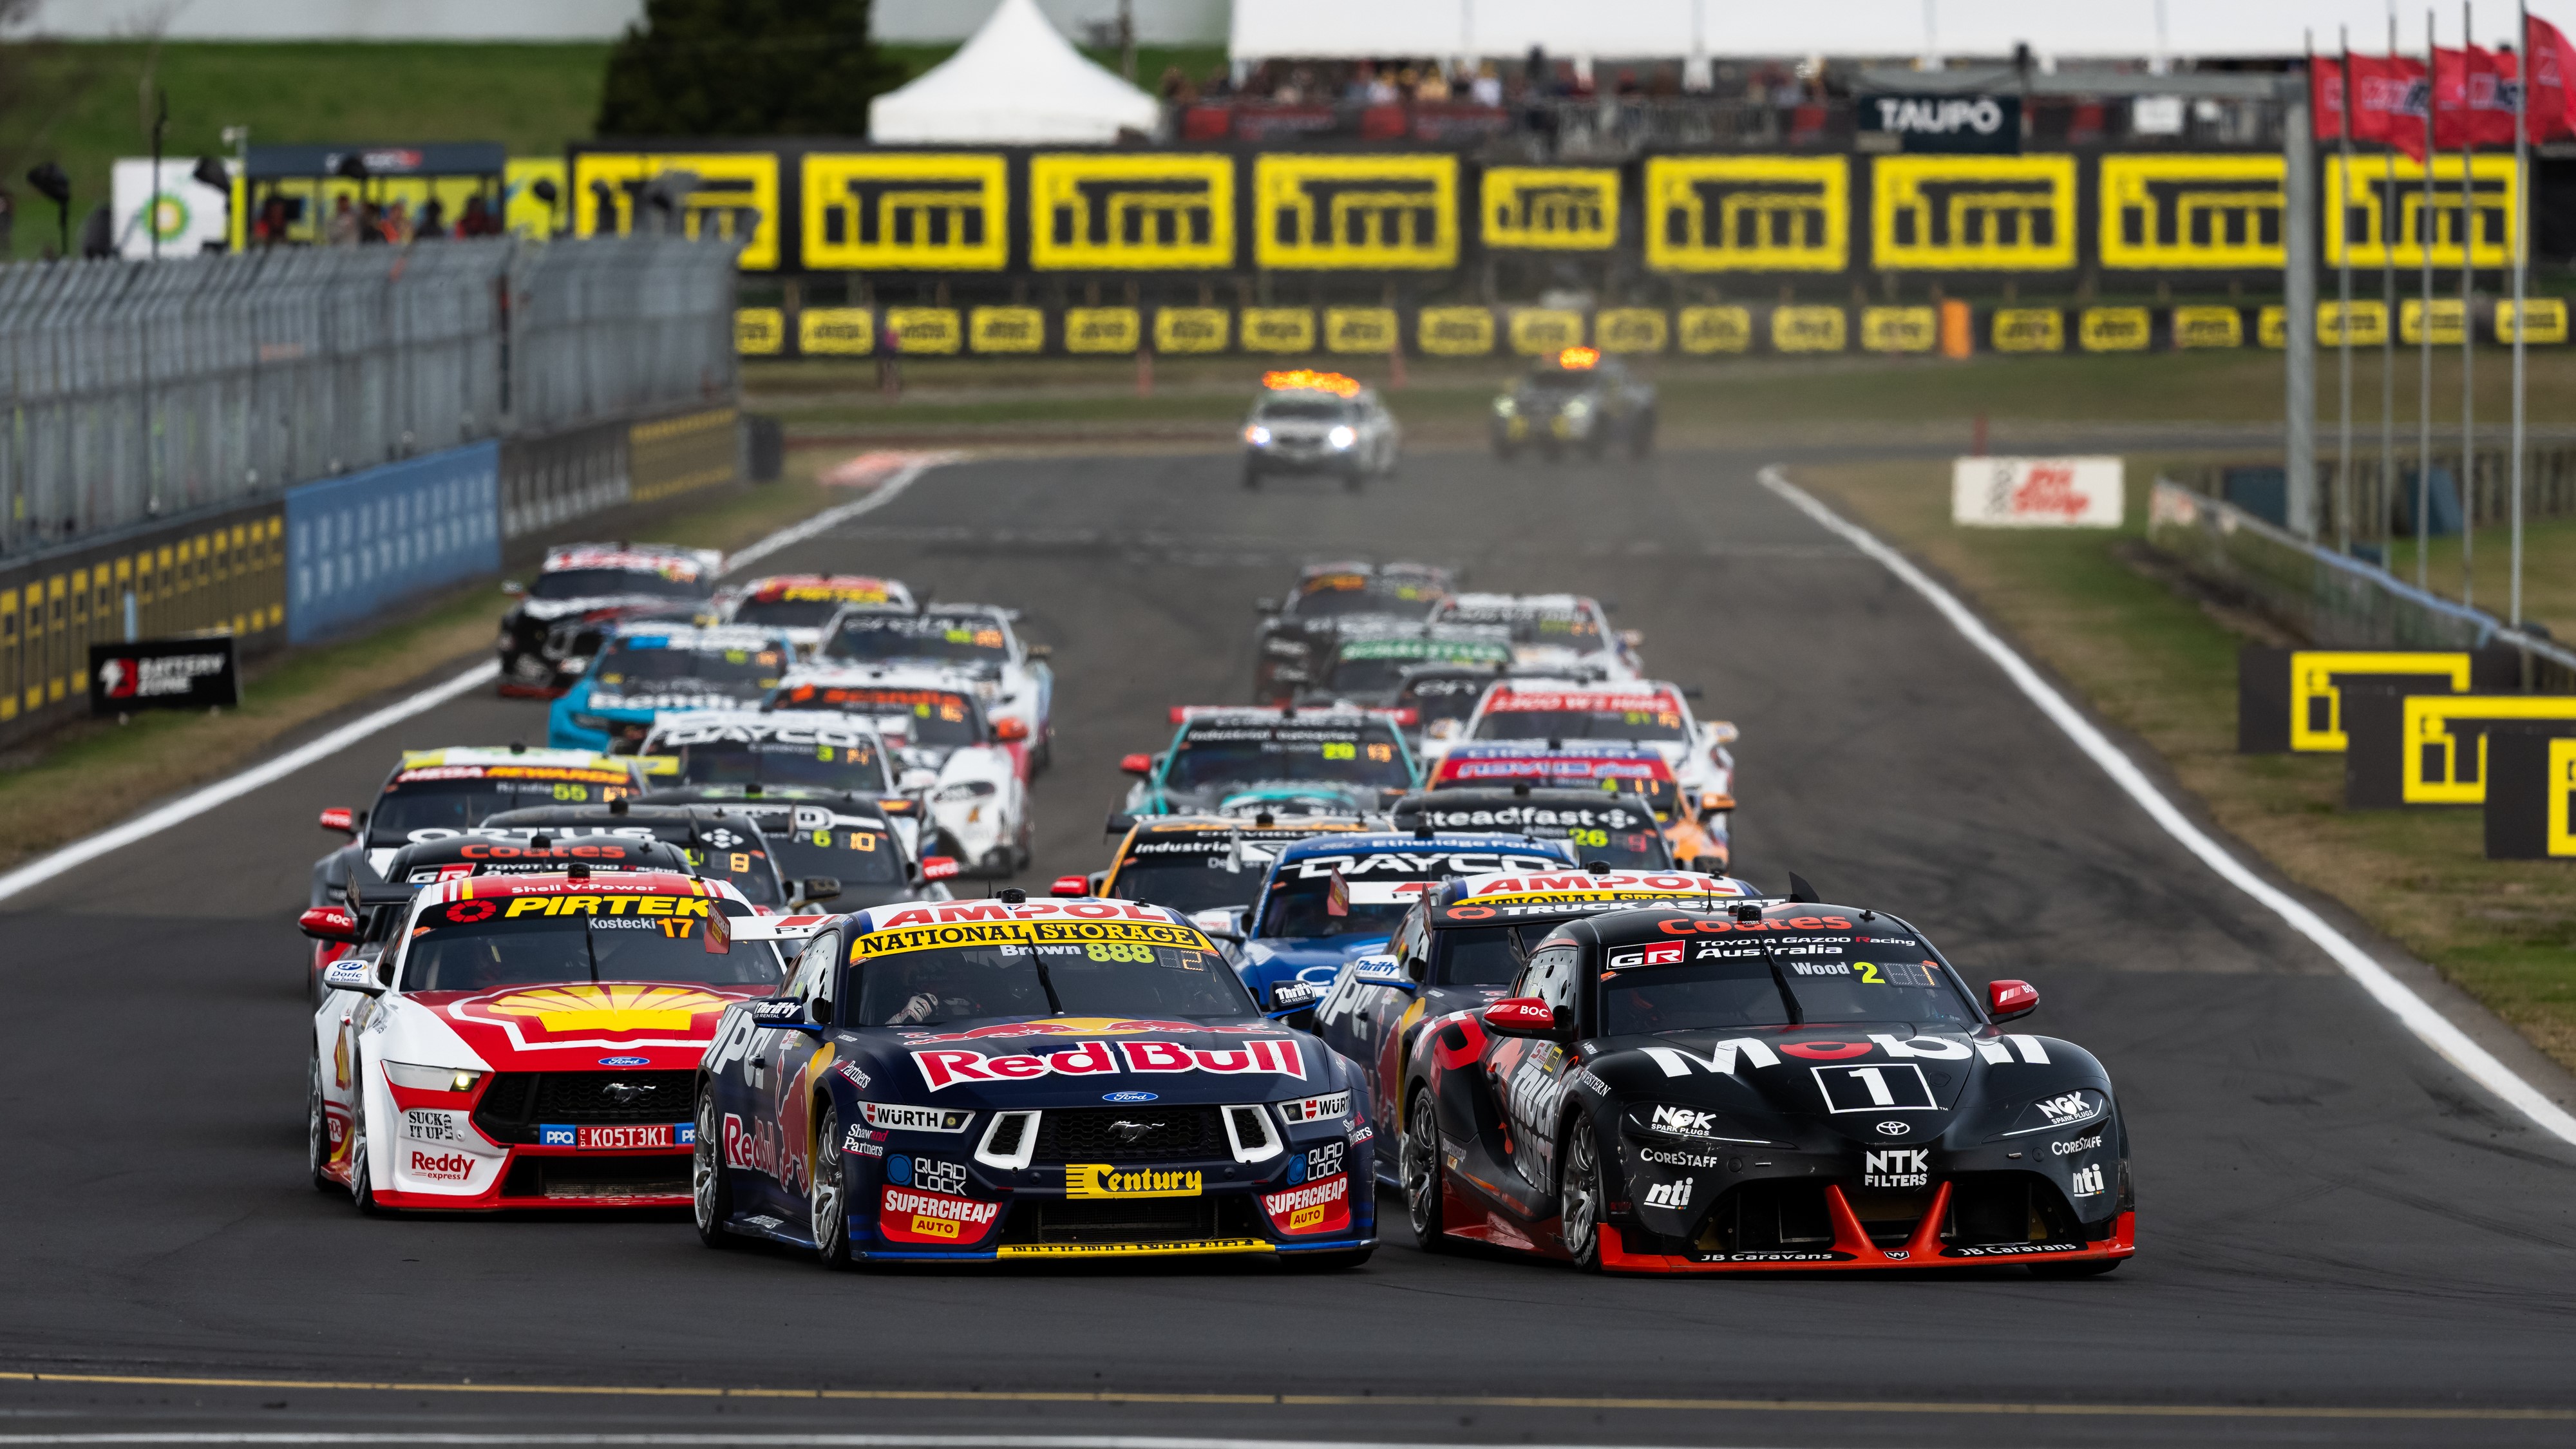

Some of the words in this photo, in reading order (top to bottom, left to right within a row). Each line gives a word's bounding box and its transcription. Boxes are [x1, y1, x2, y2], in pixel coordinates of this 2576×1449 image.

[138, 652, 225, 681] BATTERY
[137, 676, 193, 697] ZONE
[665, 727, 859, 748] DAYCO
[1322, 741, 1356, 760] 20
[553, 782, 588, 802] 55
[813, 830, 831, 848] 6
[850, 831, 876, 852] 10
[1135, 841, 1231, 853] Industria
[1371, 838, 1474, 849] Etheridge
[1478, 840, 1545, 851] Ford
[1567, 828, 1608, 848] 26
[460, 844, 626, 859] Coates
[409, 864, 474, 883] GR
[730, 852, 750, 874] 8
[1298, 853, 1560, 879] DAYCO
[511, 883, 562, 894] Shell
[568, 883, 658, 893] V-Power
[1477, 875, 1737, 896] AMPOL
[504, 895, 719, 917] PIRTEK
[882, 903, 1167, 929] AMPOL
[1502, 902, 1649, 916] TRUCK
[1651, 898, 1786, 910] ASSIST
[325, 913, 351, 927] BOC
[589, 917, 656, 930] Kostecki
[656, 918, 695, 938] 17
[1657, 914, 1852, 935] Coates
[860, 924, 1030, 954] NATIONAL
[1040, 923, 1196, 945] STORAGE
[1696, 937, 1776, 947] TOYOTA
[1855, 936, 1916, 947] Racing
[999, 943, 1081, 956] Brown
[1085, 942, 1155, 963] 888
[1180, 950, 1204, 971] 2
[1610, 946, 1683, 968] GR
[1696, 944, 1842, 960] Australia
[1356, 960, 1399, 976] Thrifty
[1791, 961, 1850, 976] Wood
[1853, 961, 1886, 984] 2
[1275, 982, 1312, 1000] Thrifty
[755, 1001, 802, 1018] Thrifty
[1519, 1005, 1549, 1018] BOC
[610, 1057, 639, 1065] Ford
[911, 1039, 1121, 1092] Red
[1119, 1038, 1308, 1082] Bull
[840, 1060, 871, 1089] Partners
[1581, 1070, 1611, 1097] WESTERN
[1112, 1091, 1149, 1101] Ford
[1848, 1067, 1895, 1106] 1
[1319, 1096, 1350, 1116] WÜRT
[2036, 1091, 2090, 1119] NGK
[408, 1111, 444, 1126] SUCK
[443, 1113, 454, 1141] LTD
[877, 1107, 938, 1128] WÜRTH
[1652, 1104, 1717, 1130] NGK
[2051, 1113, 2074, 1125] SPARK
[2073, 1109, 2094, 1121] PLUGS
[409, 1124, 422, 1138] IT
[425, 1126, 444, 1140] UP
[547, 1131, 574, 1144] PPQ
[1651, 1122, 1678, 1133] SPARK
[1680, 1127, 1710, 1137] PLUGS
[842, 1136, 884, 1157] Partners
[1308, 1141, 1345, 1165] QUAD
[411, 1150, 476, 1180] Reddy
[914, 1157, 966, 1180] QUAD
[1307, 1157, 1343, 1182] LOCK
[1866, 1148, 1929, 1173] NTK
[427, 1171, 461, 1181] express
[914, 1171, 967, 1197] LOCK
[1095, 1164, 1202, 1193] Century
[1864, 1173, 1927, 1188] FILTERS
[2072, 1163, 2105, 1193] nti
[1266, 1178, 1348, 1217] SUPERCHEAP
[1646, 1177, 1694, 1206] nti
[884, 1190, 997, 1225] SUPERCHEAP
[1293, 1208, 1322, 1226] AUTO
[916, 1218, 954, 1235] AUTO
[1731, 1253, 1833, 1261] Caravans
[1958, 1247, 1984, 1256] JB
[1985, 1242, 2077, 1255] Caravans
